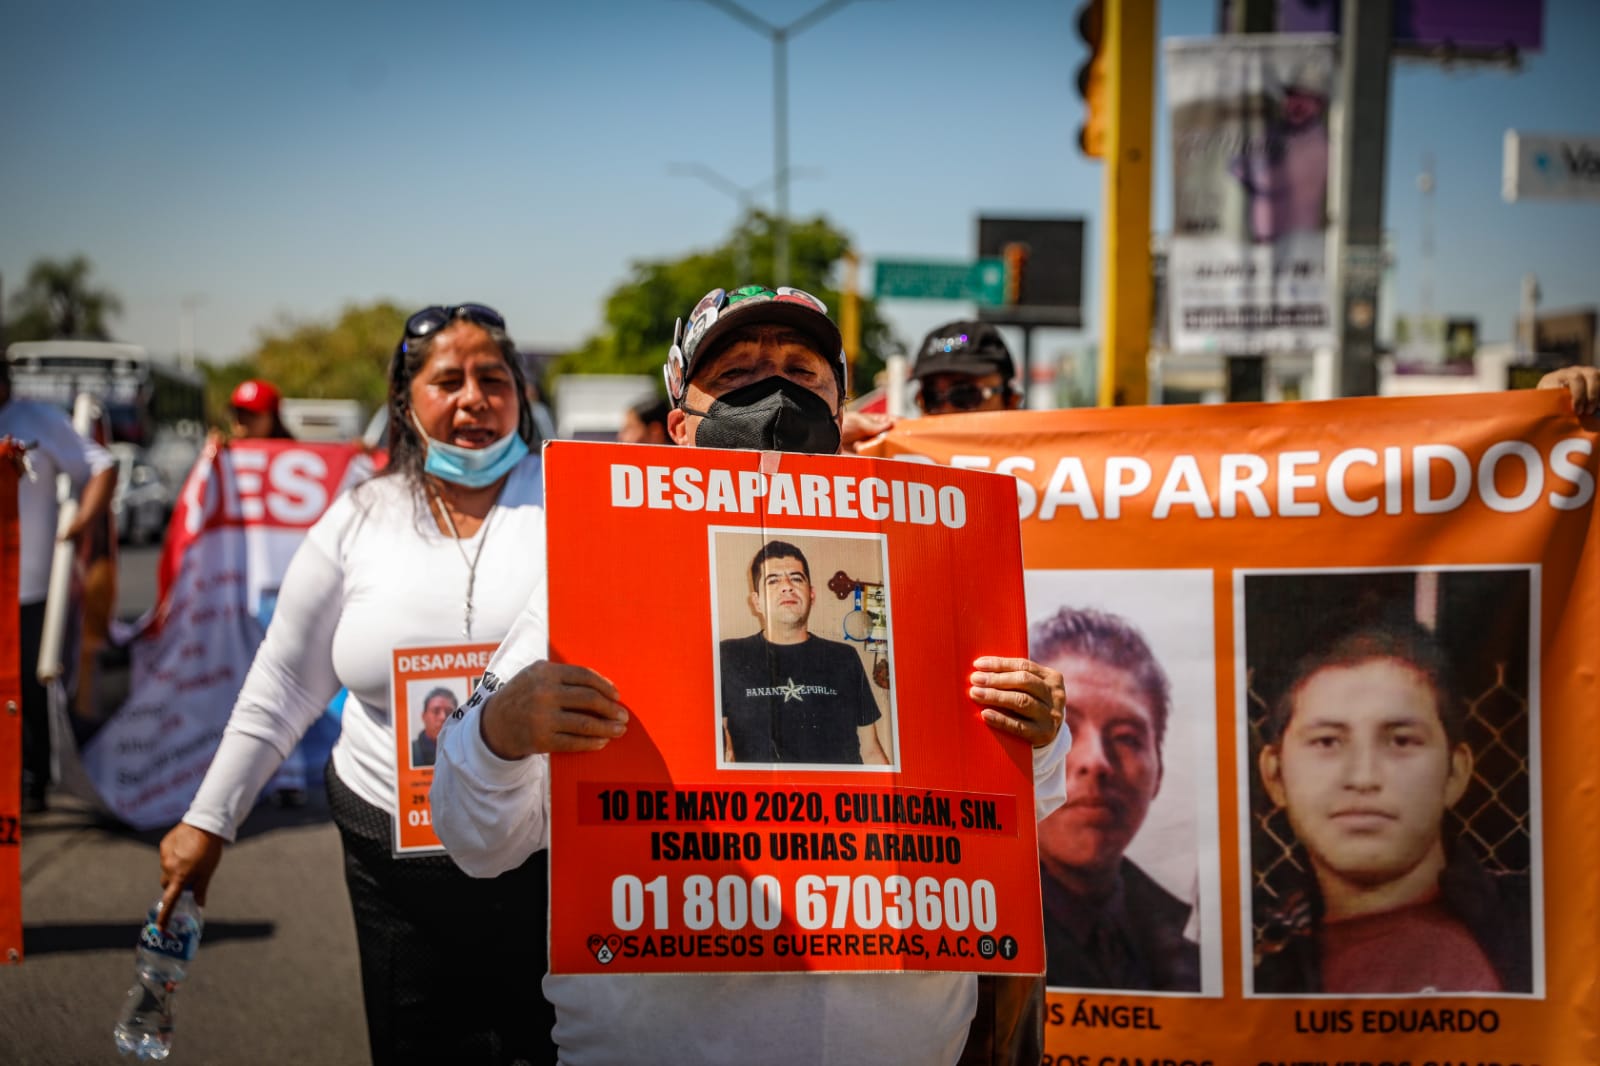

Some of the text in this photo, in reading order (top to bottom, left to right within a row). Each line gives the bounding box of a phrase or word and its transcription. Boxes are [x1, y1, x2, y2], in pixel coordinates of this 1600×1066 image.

[610, 463, 967, 529] DESAPARECIDO
[893, 437, 1595, 521] SAPARECIDOS
[598, 790, 1002, 831] 10 DE MAYO 2020, CULIACÁN, SIN.
[652, 832, 961, 865] ISAURO URIAS ARAUJO
[611, 874, 997, 932] 01 800 6703600
[623, 934, 975, 960] SABUESOS GUERRERAS, A.C.
[1071, 999, 1163, 1030] ÁNGEL
[1295, 1009, 1500, 1034] LUIS EDUARDO
